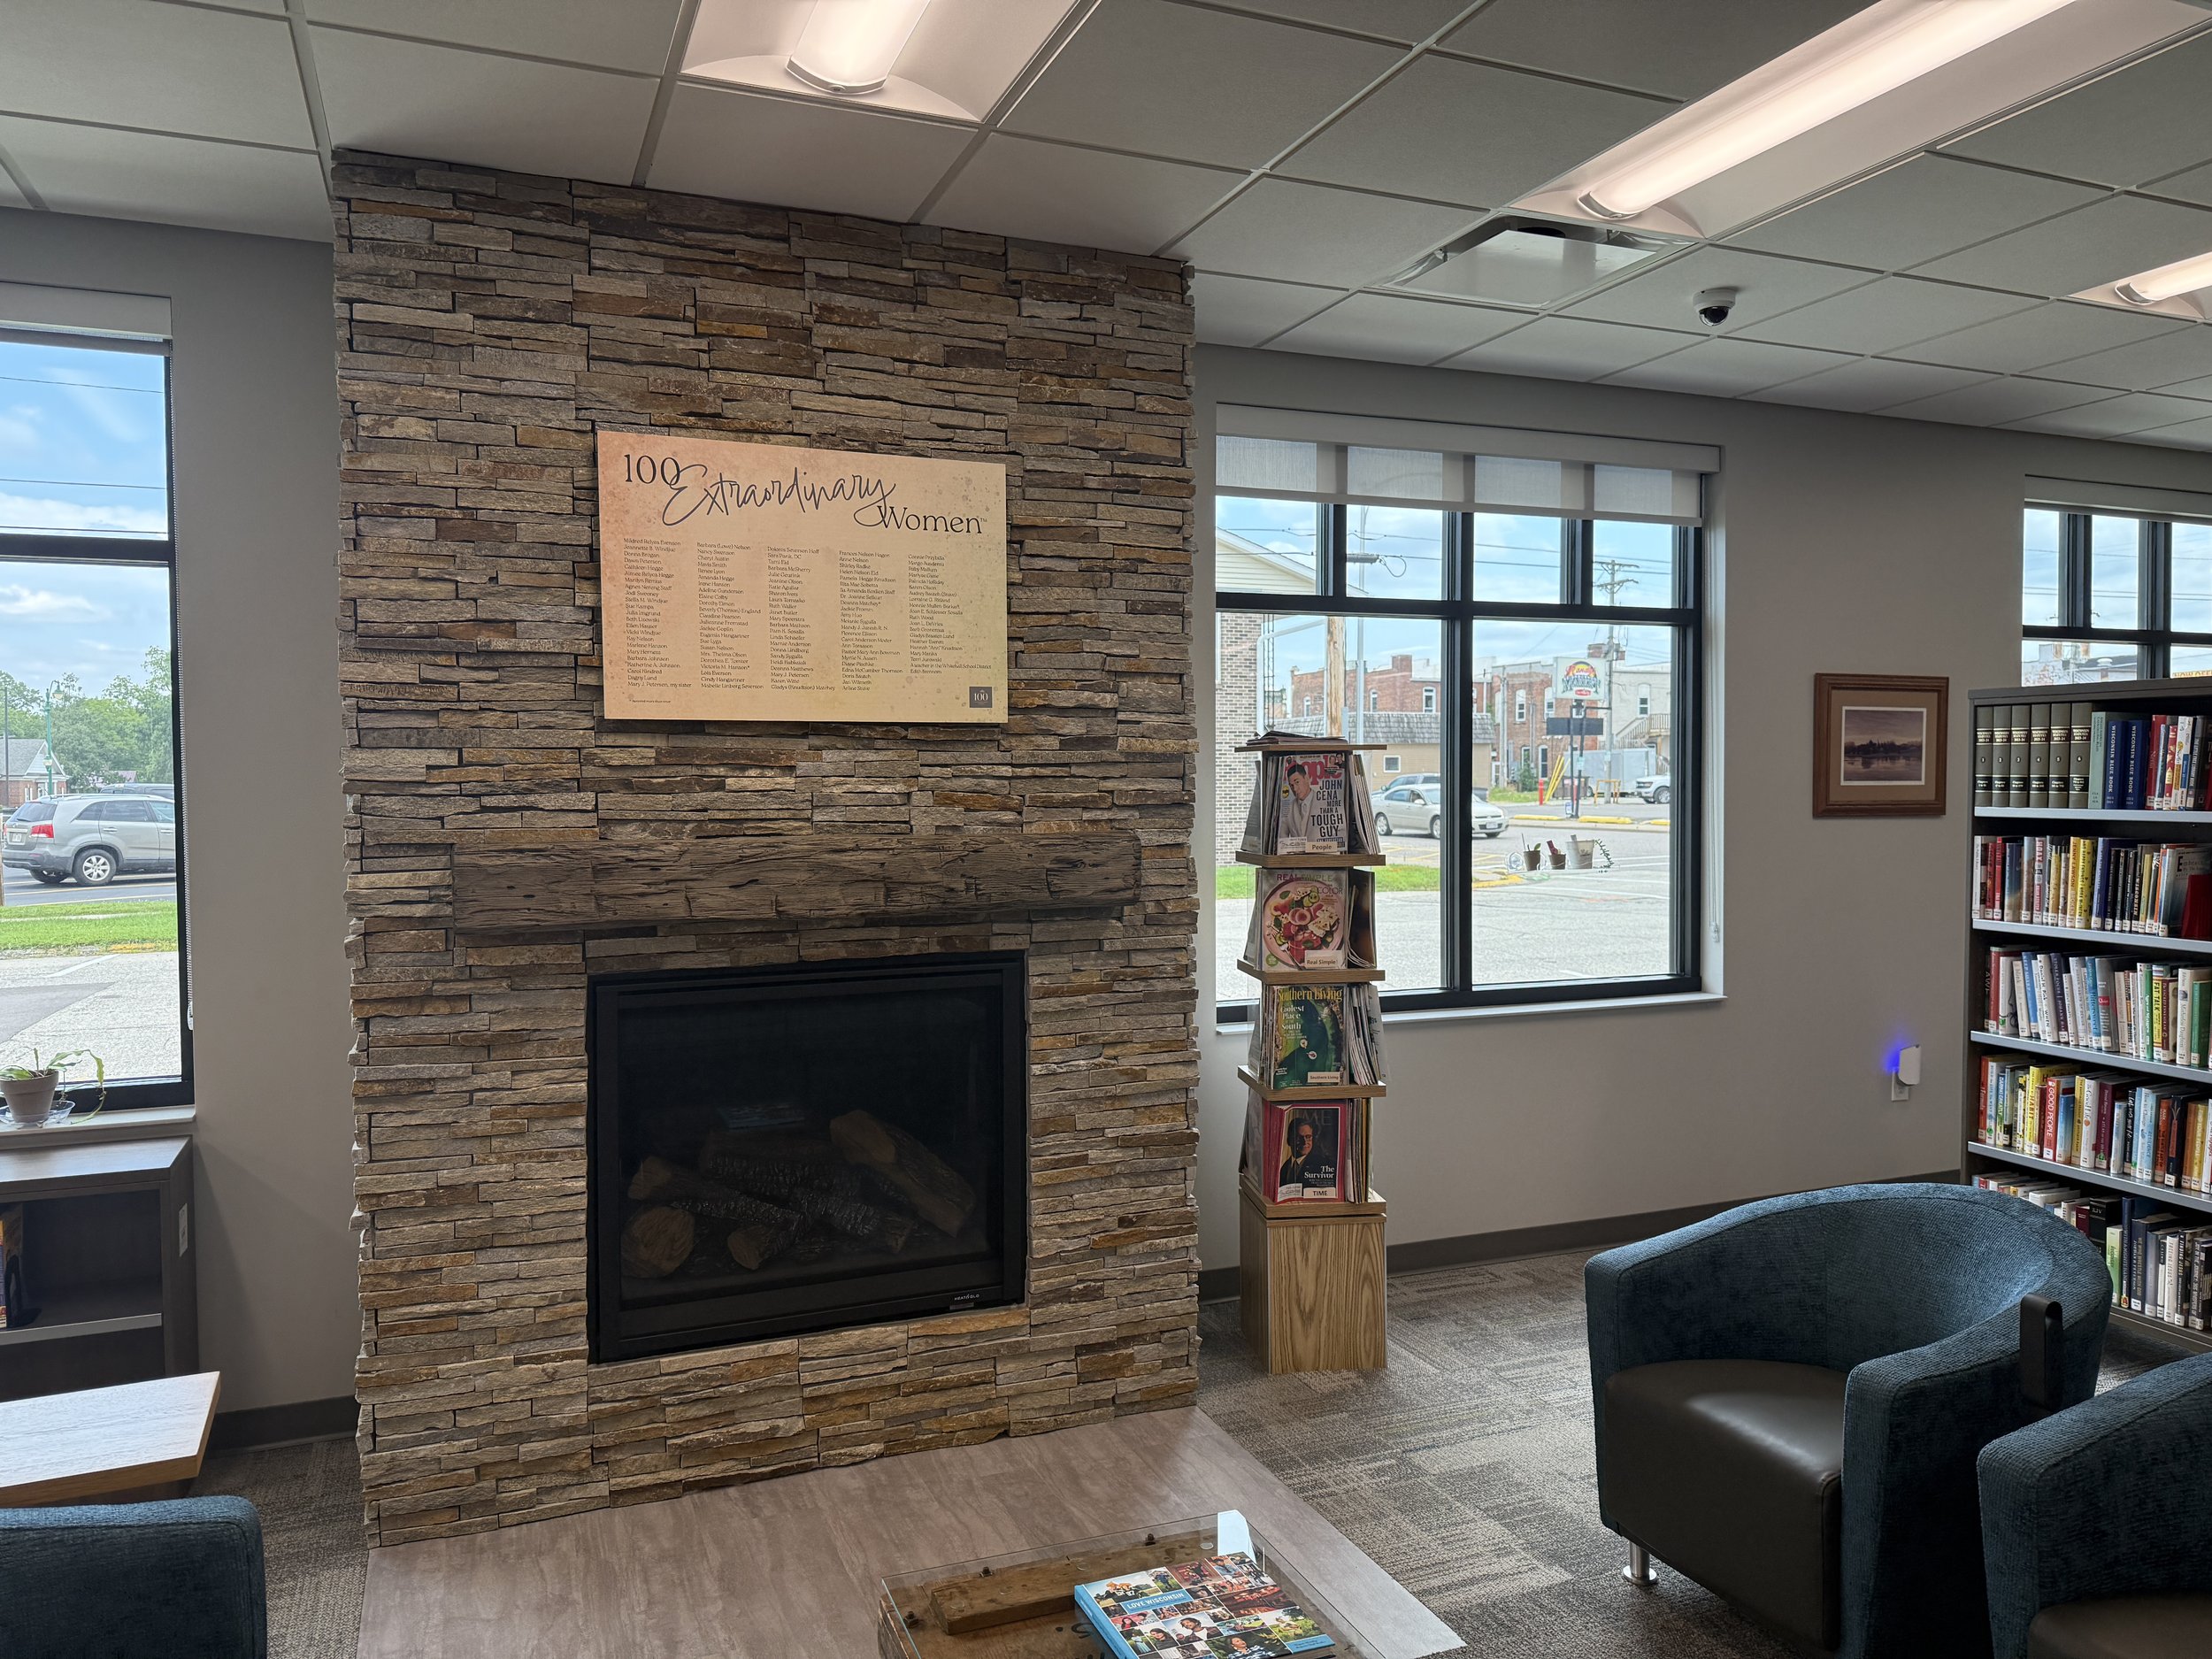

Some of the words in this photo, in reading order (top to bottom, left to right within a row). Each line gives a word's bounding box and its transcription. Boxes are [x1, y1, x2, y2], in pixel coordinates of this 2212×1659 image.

[625, 454, 680, 485] 100
[662, 465, 895, 526] Extraordinary
[878, 505, 981, 534] Women
[1319, 780, 1342, 790] JOHN
[1316, 791, 1338, 801] CENA
[1310, 814, 1343, 826] TOUGH
[1319, 826, 1339, 837] GUY
[1314, 988, 1342, 1002] Living
[1281, 1022, 1302, 1031] South
[1145, 1593, 1185, 1605] WISCONSIN
